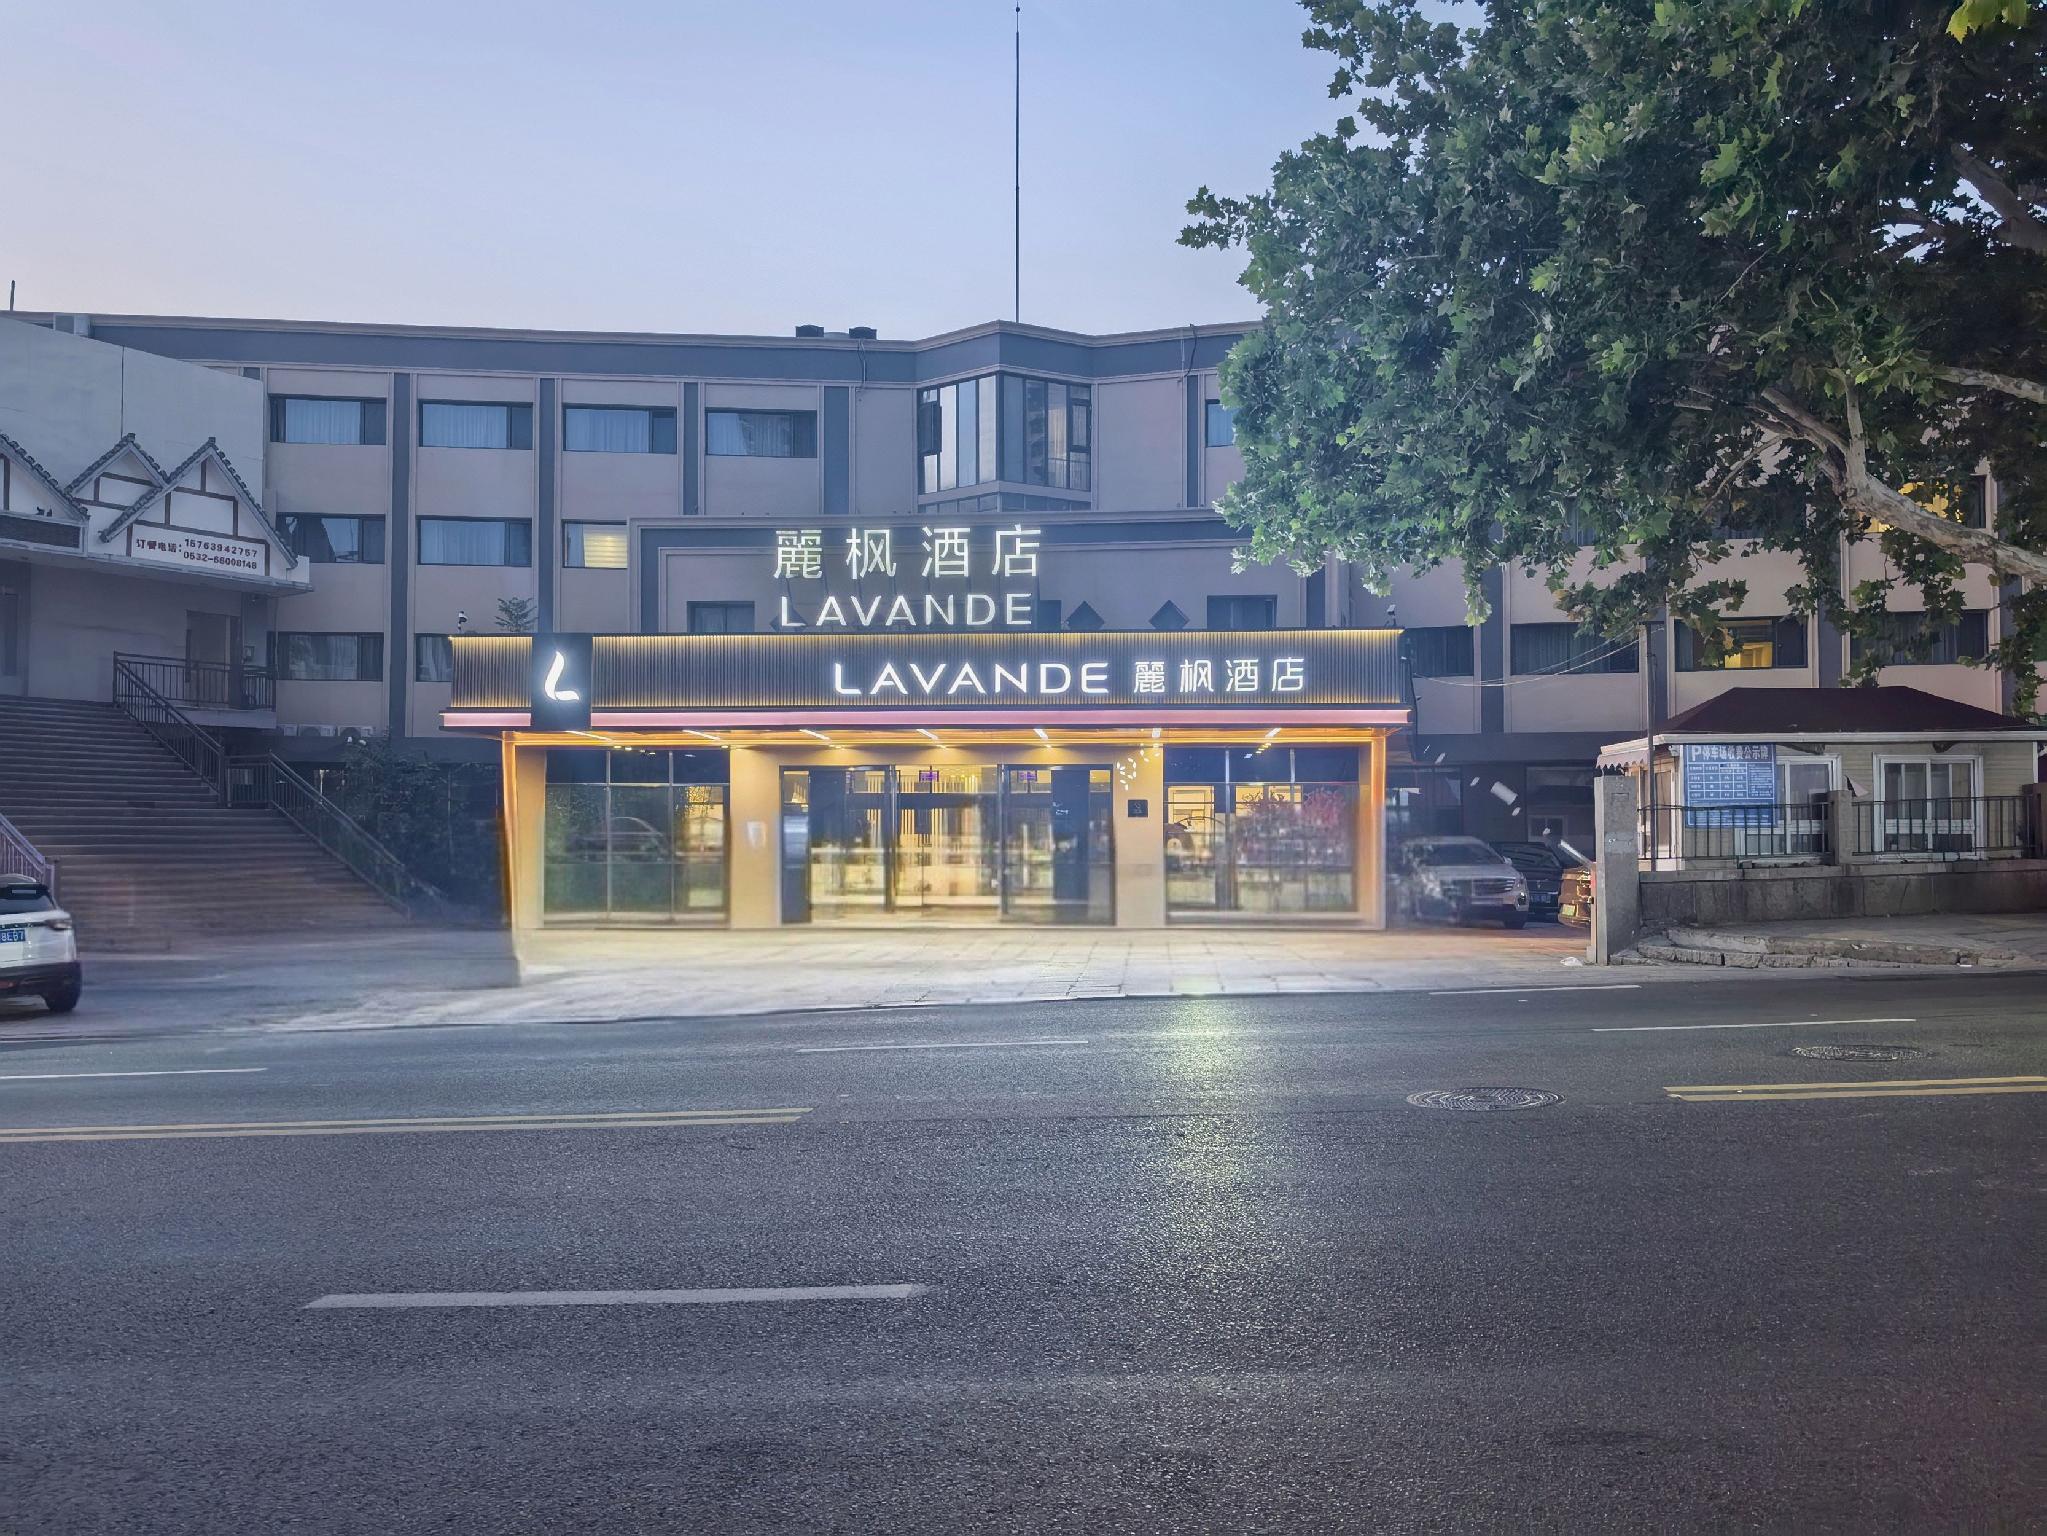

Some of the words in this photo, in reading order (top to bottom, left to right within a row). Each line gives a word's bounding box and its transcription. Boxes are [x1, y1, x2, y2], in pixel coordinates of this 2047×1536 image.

[774, 524, 1041, 580] 麗枫酒店
[781, 593, 1031, 627] LAVANDE
[834, 662, 1108, 695] LAVANDE
[1134, 657, 1305, 693] 麗枫酒店
